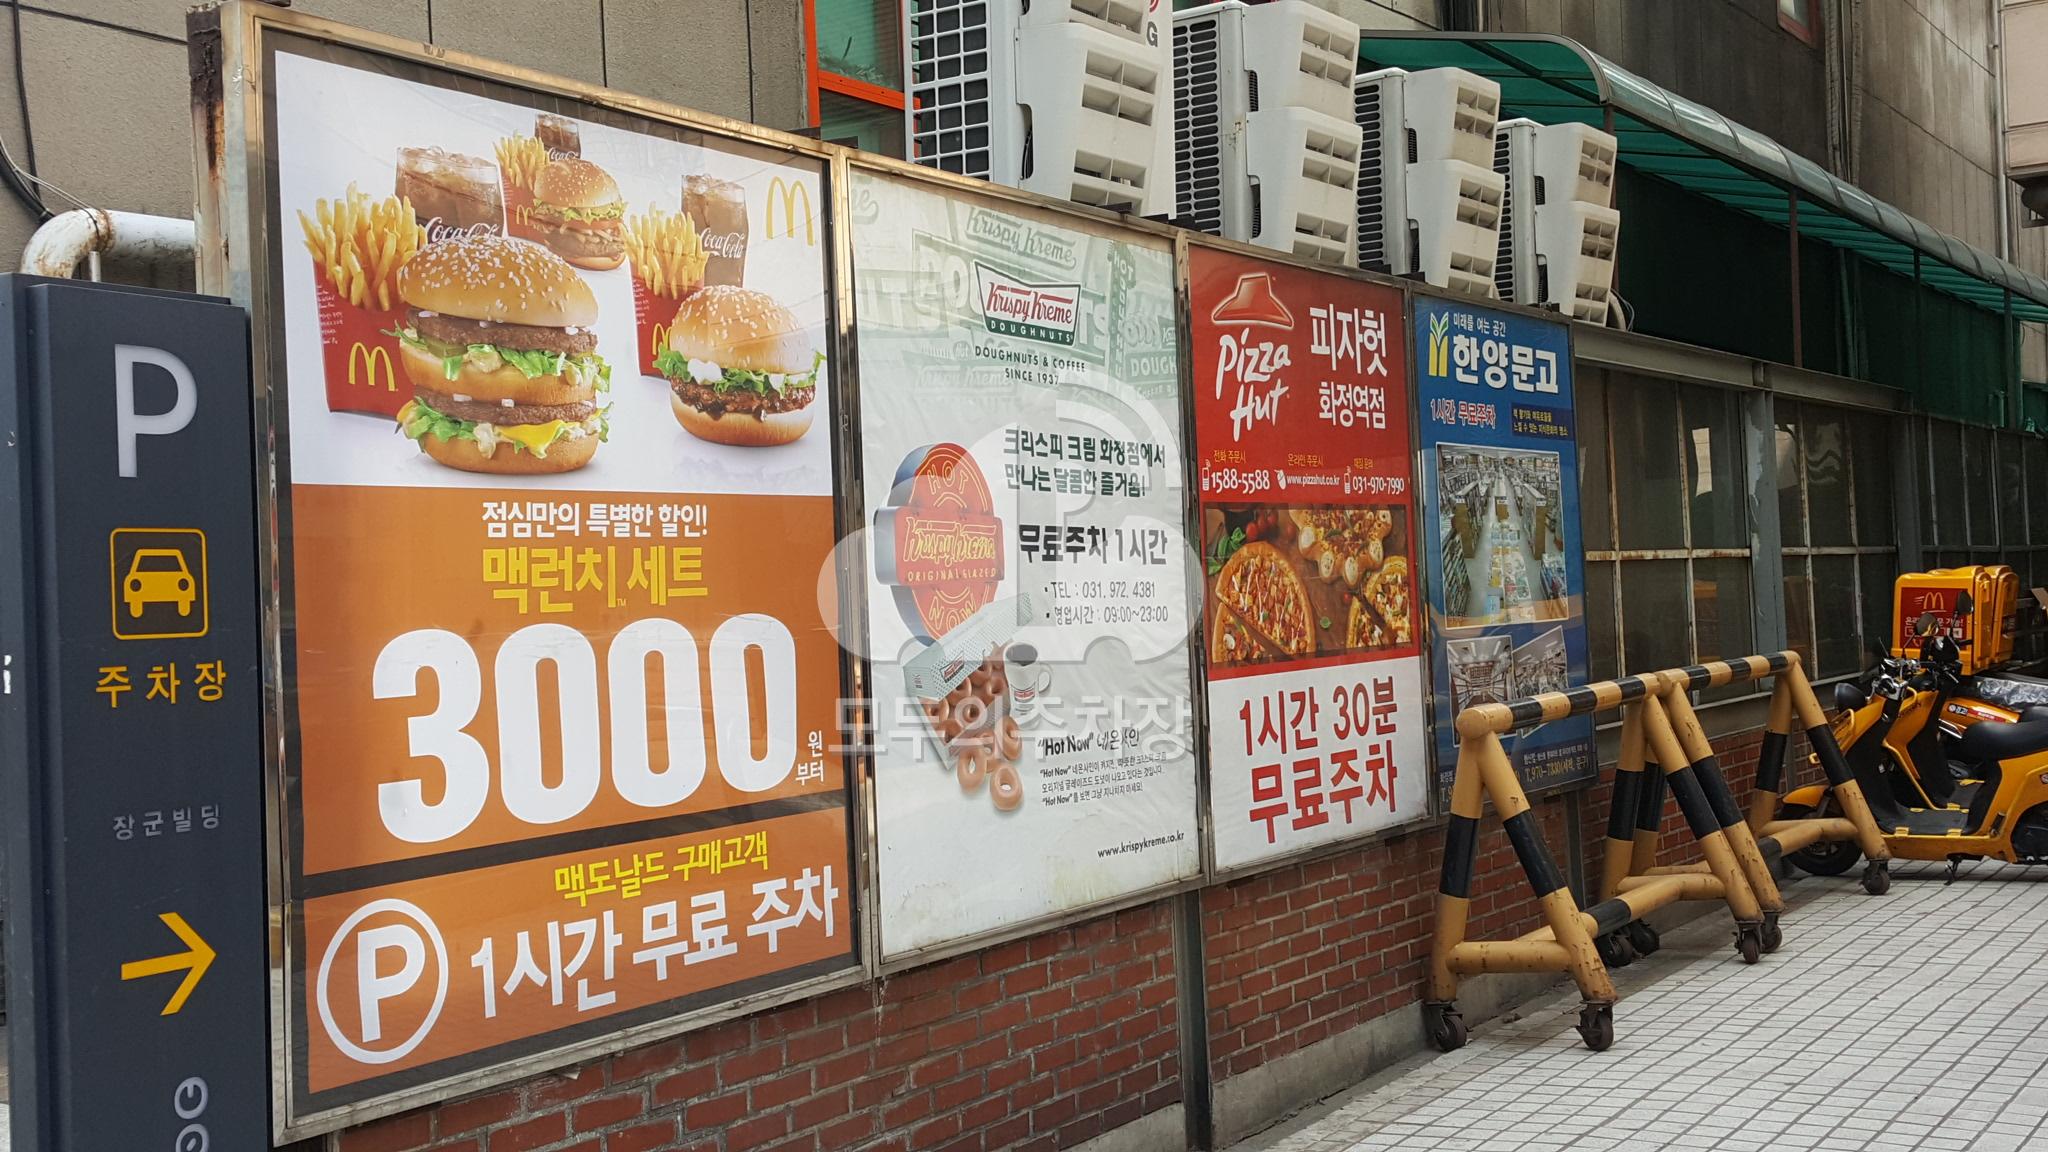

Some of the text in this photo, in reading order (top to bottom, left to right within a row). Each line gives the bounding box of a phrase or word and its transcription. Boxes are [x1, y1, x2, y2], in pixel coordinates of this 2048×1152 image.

[986, 282, 1074, 324] Krispy Kreme
[990, 320, 1071, 342] DOUGHNUTS
[1310, 304, 1387, 377] 피자헛
[1454, 312, 1506, 338] 미래를 여는 공간
[975, 346, 1085, 372] DOUGHNUTS & COFFEE
[1005, 368, 1059, 385] SINCE 1937
[1216, 328, 1291, 400] Pizza
[1453, 334, 1559, 394] 한양문고
[114, 343, 198, 478] P
[1230, 378, 1289, 441] Hut
[1319, 381, 1386, 429] 화정역점
[1430, 398, 1497, 430] 1시간 무료주차
[1004, 428, 1166, 468] 크리스피 크림 화정점에서
[927, 461, 969, 495] HOT
[1005, 464, 1146, 498] 만나는 달콤한 즐거움!
[1211, 468, 1270, 494] 1588-5588
[1287, 474, 1340, 487] www.pizzahut.co.kr
[1353, 476, 1404, 495] 031-970-7990
[481, 501, 708, 538] 점심만의 특별한 할인!
[1018, 524, 1108, 564] 무료주차
[482, 545, 617, 614] 맥런치
[627, 545, 708, 606] 세트
[1055, 606, 1094, 625] 영업시간
[1104, 606, 1169, 624] 09:00~23:00
[95, 659, 228, 708] 주차장
[372, 612, 797, 844] 3000
[1240, 675, 1398, 756] 1시간 30분
[808, 730, 823, 757] 원
[1097, 728, 1140, 751] 네온사인
[796, 760, 824, 786] 부터
[1042, 781, 1065, 793] 오리지널
[1066, 777, 1093, 790] 글레이즈드
[1111, 771, 1127, 783] 나오고
[1072, 761, 1100, 774] 네온사인이
[1249, 740, 1398, 844] 무료주차
[112, 804, 221, 840] 장군빌딩
[1097, 829, 1185, 858] www.krispykreme.co.kr
[554, 831, 769, 907] 맥도날드 구매고객
[471, 865, 839, 1018] 1시간 무료 주차
[357, 923, 426, 1043] P
